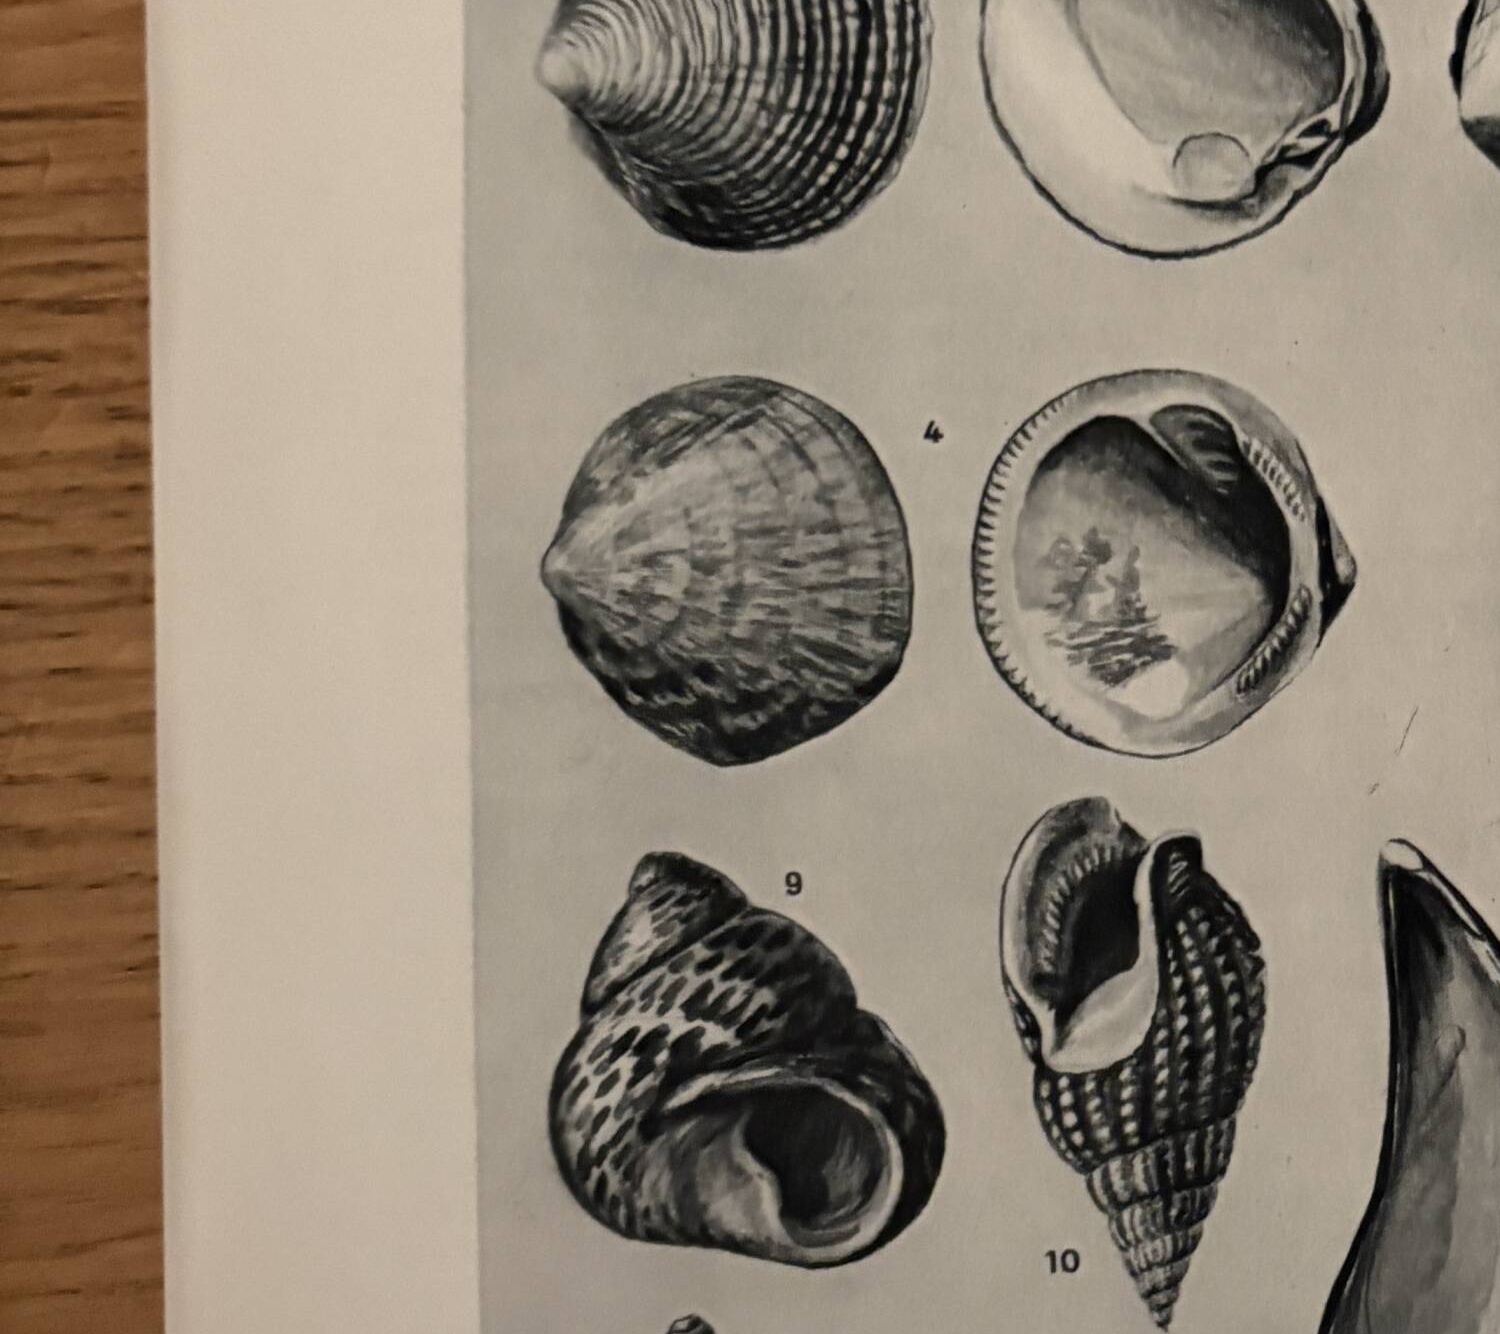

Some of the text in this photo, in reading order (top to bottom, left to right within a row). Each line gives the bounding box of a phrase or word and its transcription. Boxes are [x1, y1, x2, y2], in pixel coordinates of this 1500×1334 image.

[922, 419, 945, 444] 4
[784, 870, 804, 898] 9
[1044, 1248, 1081, 1276] 10
